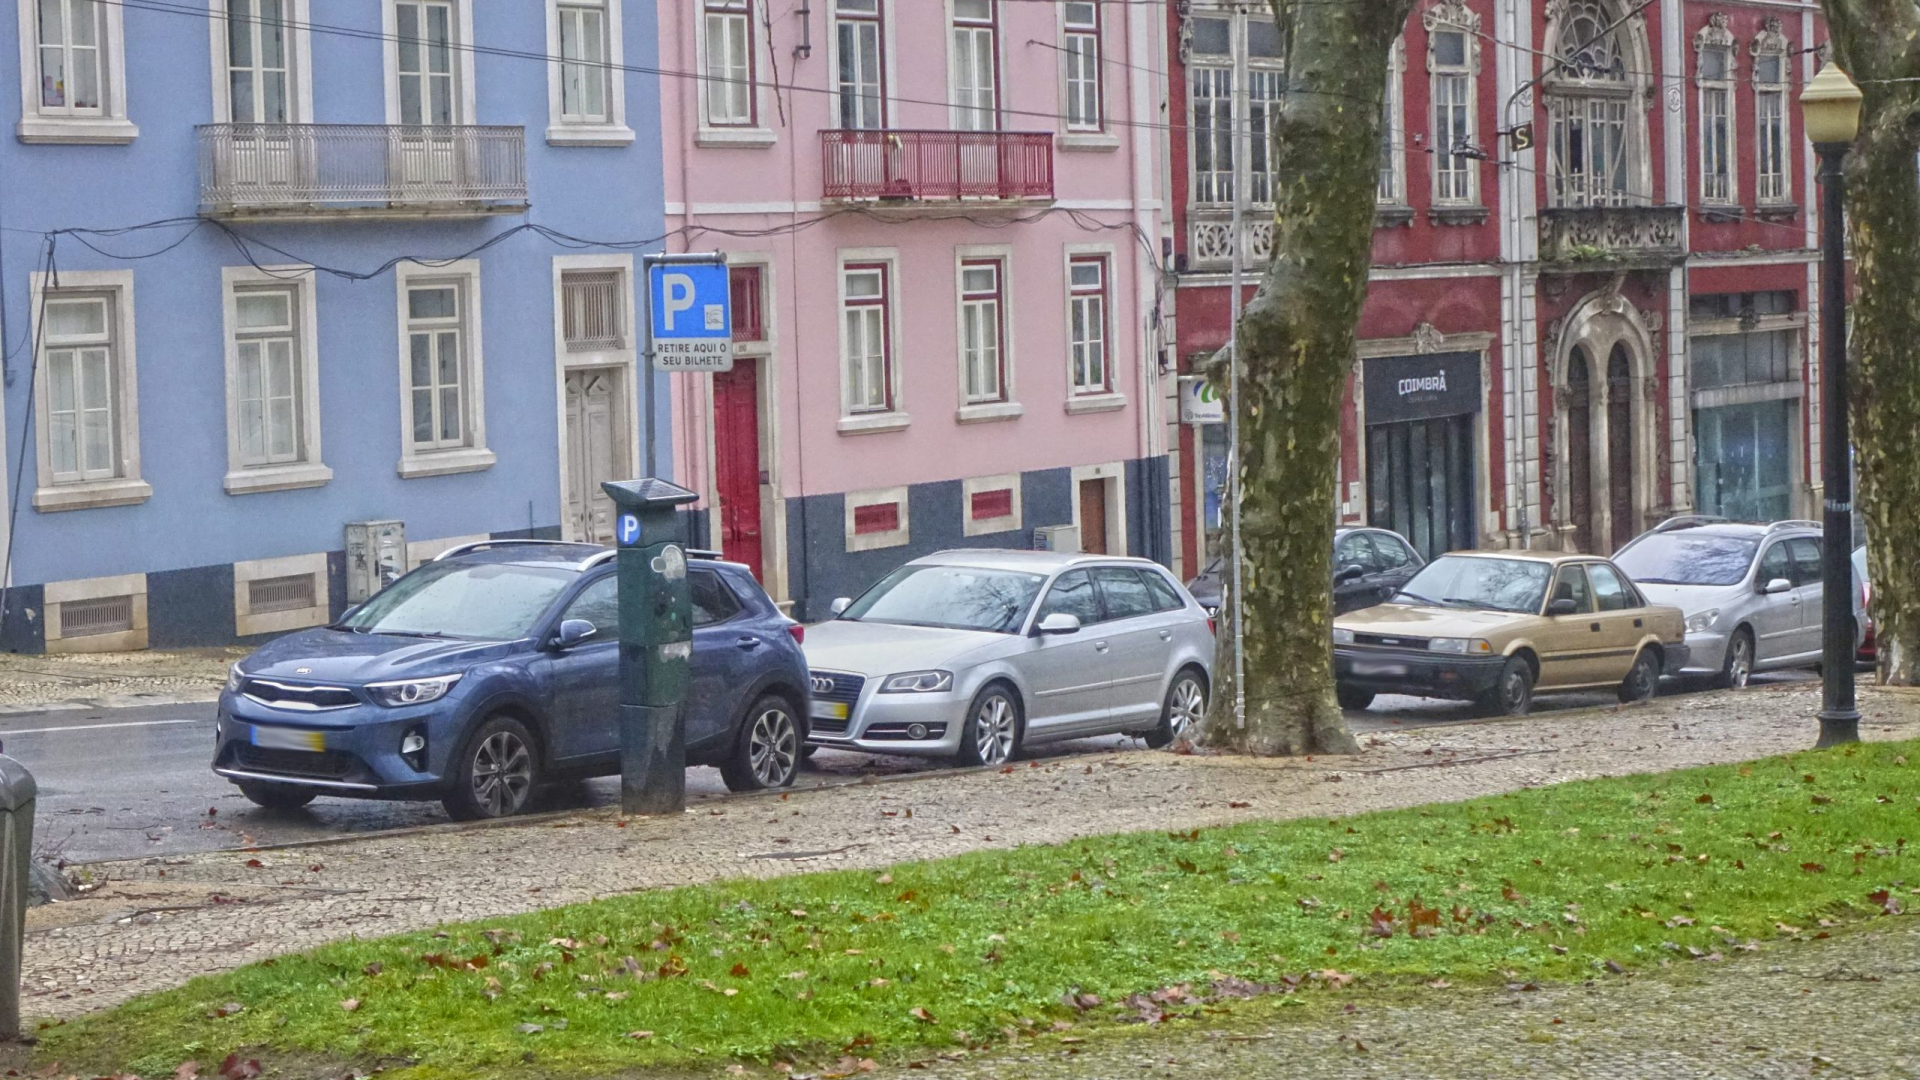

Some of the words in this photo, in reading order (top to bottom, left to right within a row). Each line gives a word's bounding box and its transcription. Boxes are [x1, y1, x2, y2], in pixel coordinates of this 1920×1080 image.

[1515, 127, 1529, 150] S
[662, 273, 696, 331] P
[657, 343, 690, 353] RETIRE
[693, 342, 717, 353] AQUI
[719, 342, 727, 352] O
[662, 356, 682, 366] SEU
[685, 355, 724, 366] BILHETE
[623, 515, 638, 542] P
